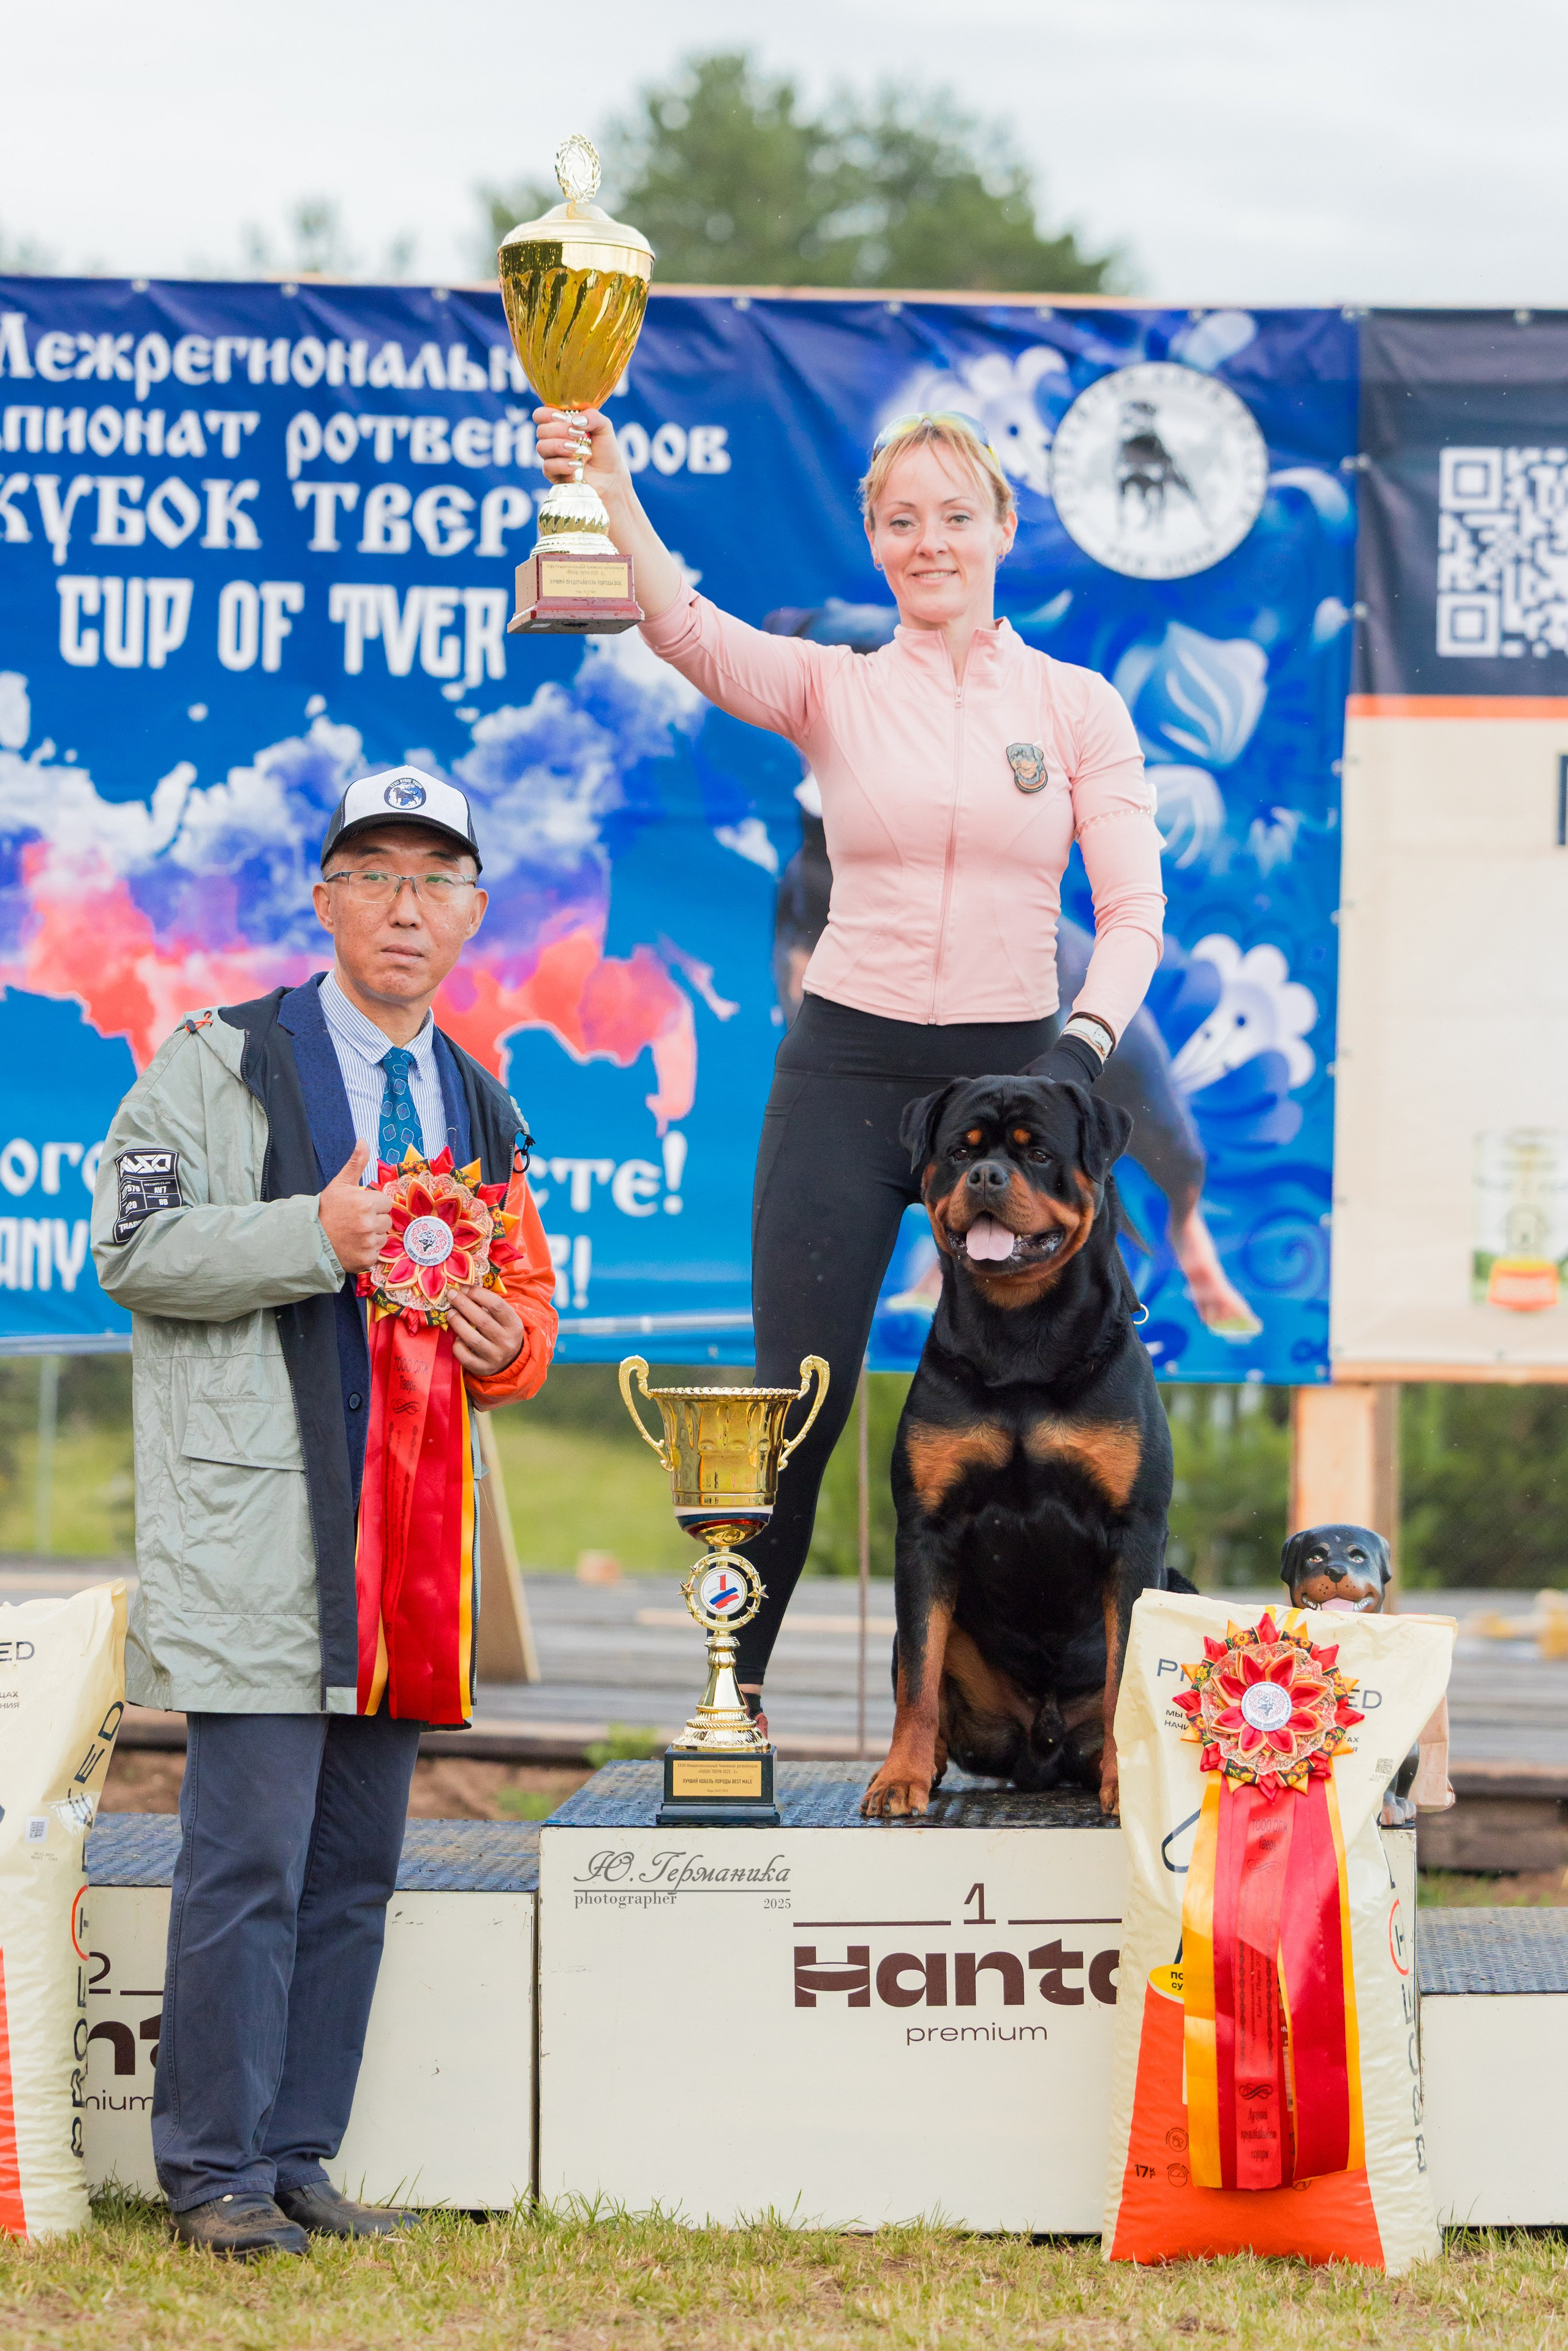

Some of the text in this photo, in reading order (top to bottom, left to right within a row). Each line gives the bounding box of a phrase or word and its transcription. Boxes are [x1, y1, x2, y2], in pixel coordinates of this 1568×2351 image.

[293, 481, 540, 557] ТВЕР
[56, 575, 508, 701] CUP OF TVER
[963, 1882, 997, 1925] 1
[907, 2022, 1048, 2046] premium
